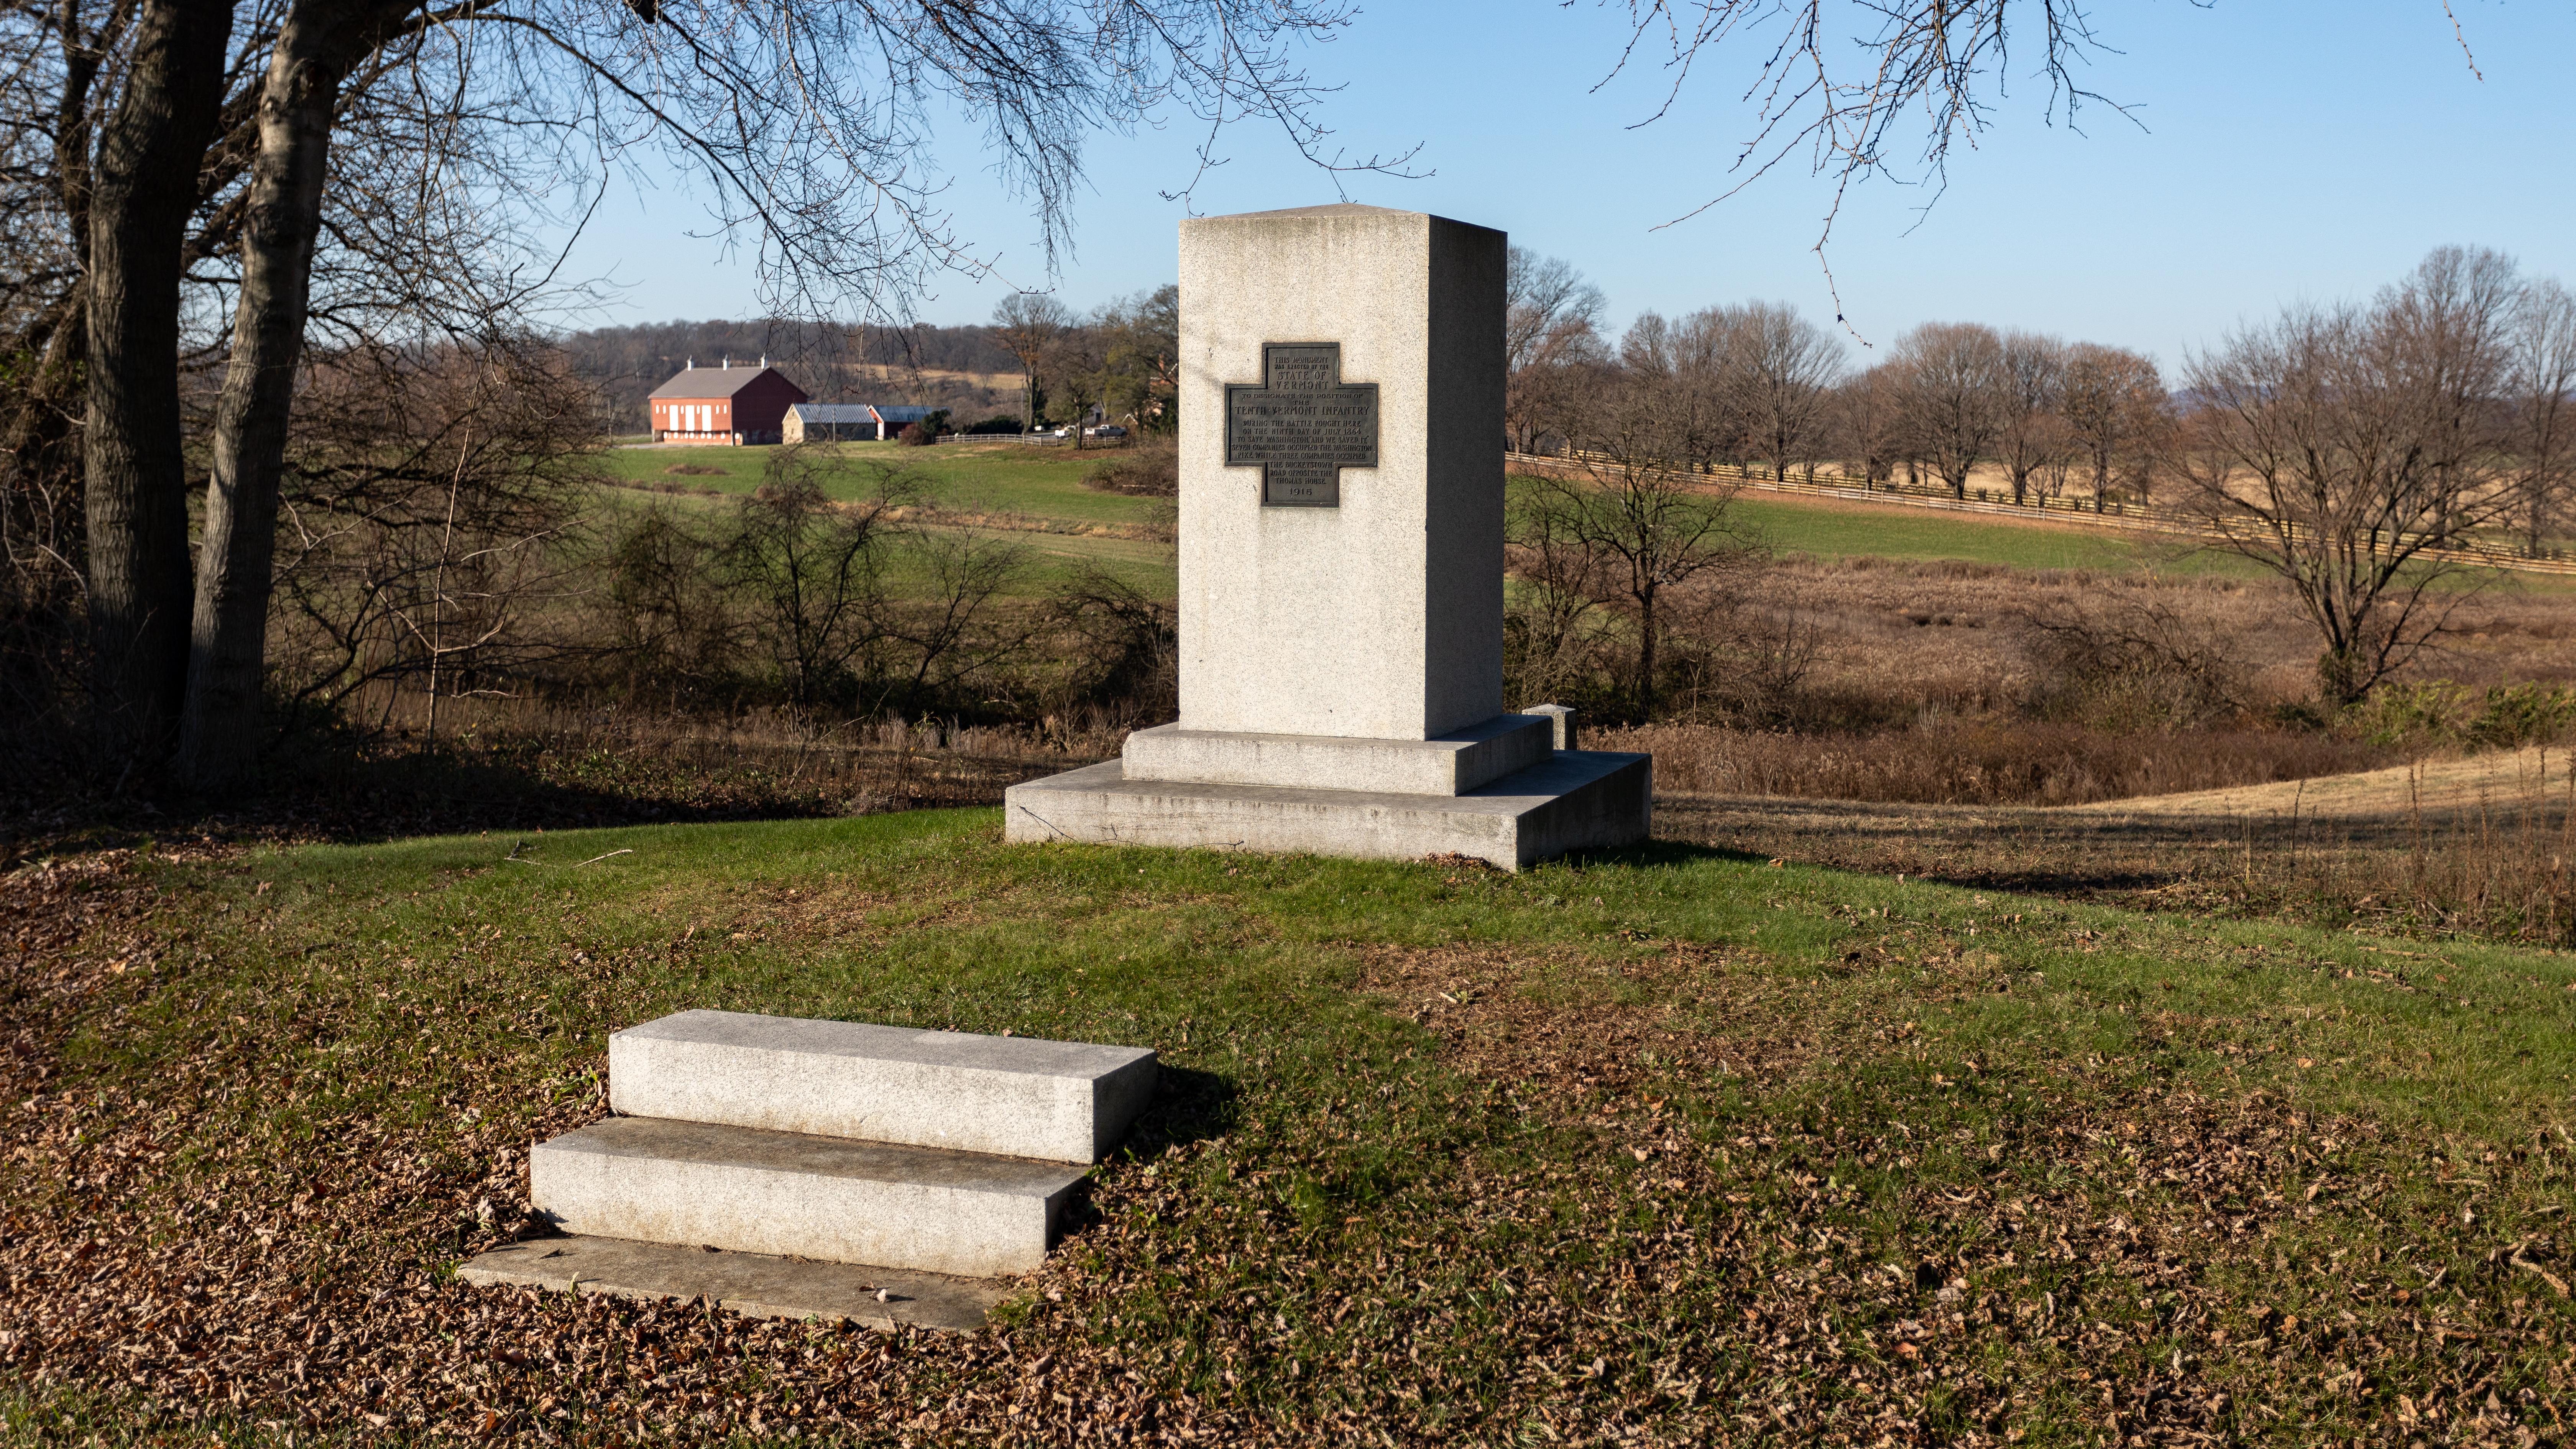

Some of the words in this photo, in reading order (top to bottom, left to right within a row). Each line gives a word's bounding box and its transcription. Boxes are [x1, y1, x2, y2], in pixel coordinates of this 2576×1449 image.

[1277, 371, 1309, 380] STATE
[1314, 371, 1326, 380] OF
[1276, 381, 1329, 389] VERMONT
[1235, 406, 1266, 414] TENTH
[1273, 406, 1317, 415] VERMONT
[1322, 406, 1369, 415] INFANTRY
